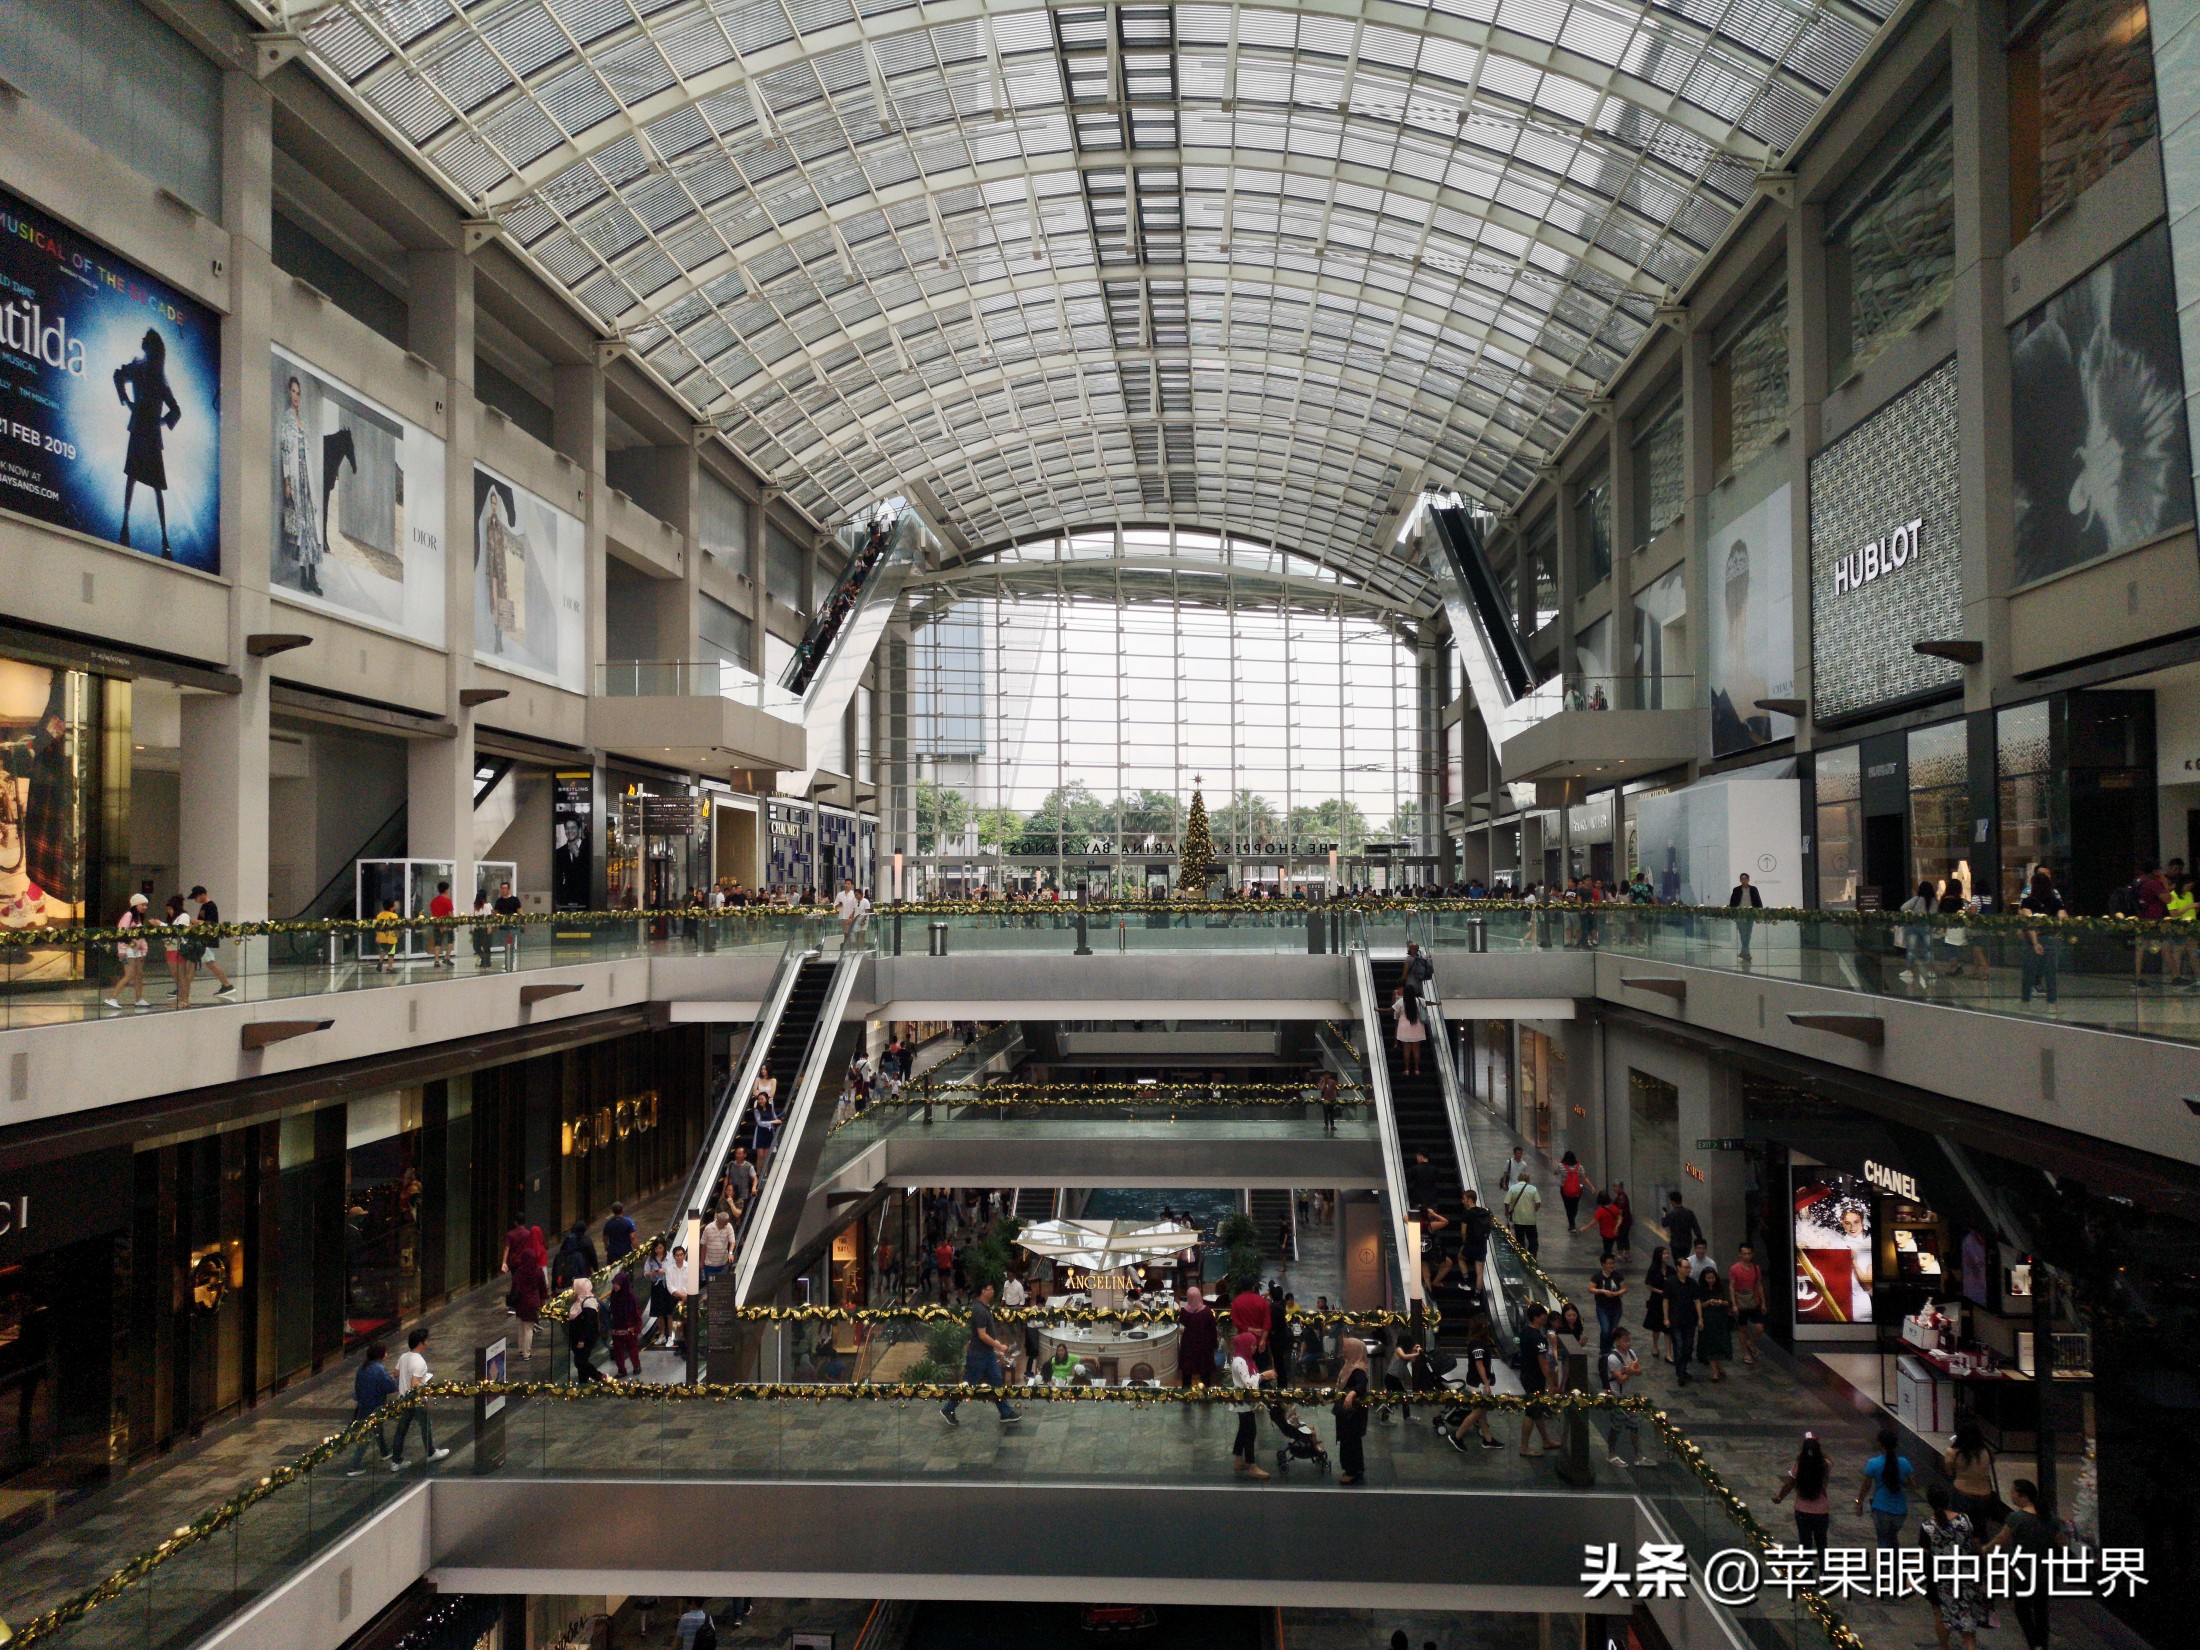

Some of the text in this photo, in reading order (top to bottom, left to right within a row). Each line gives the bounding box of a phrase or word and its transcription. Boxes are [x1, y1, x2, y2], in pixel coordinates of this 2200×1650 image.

[72, 253, 94, 272] OF
[98, 266, 125, 293] THE
[129, 282, 188, 326] DECADE
[12, 422, 40, 447] FEB
[44, 435, 77, 460] 2019
[8, 462, 30, 479] NOW
[31, 472, 42, 482] AT
[0, 473, 59, 501] AYSANDS.COM
[412, 527, 438, 551] DIOR
[1835, 517, 1922, 595] HUBLOT
[563, 595, 580, 614] DIOR
[1313, 890, 1318, 900] 1
[1697, 1141, 1711, 1149] EXIT
[1864, 1159, 1920, 1203] CHANEL
[1065, 1275, 1135, 1290] ANGELINA
